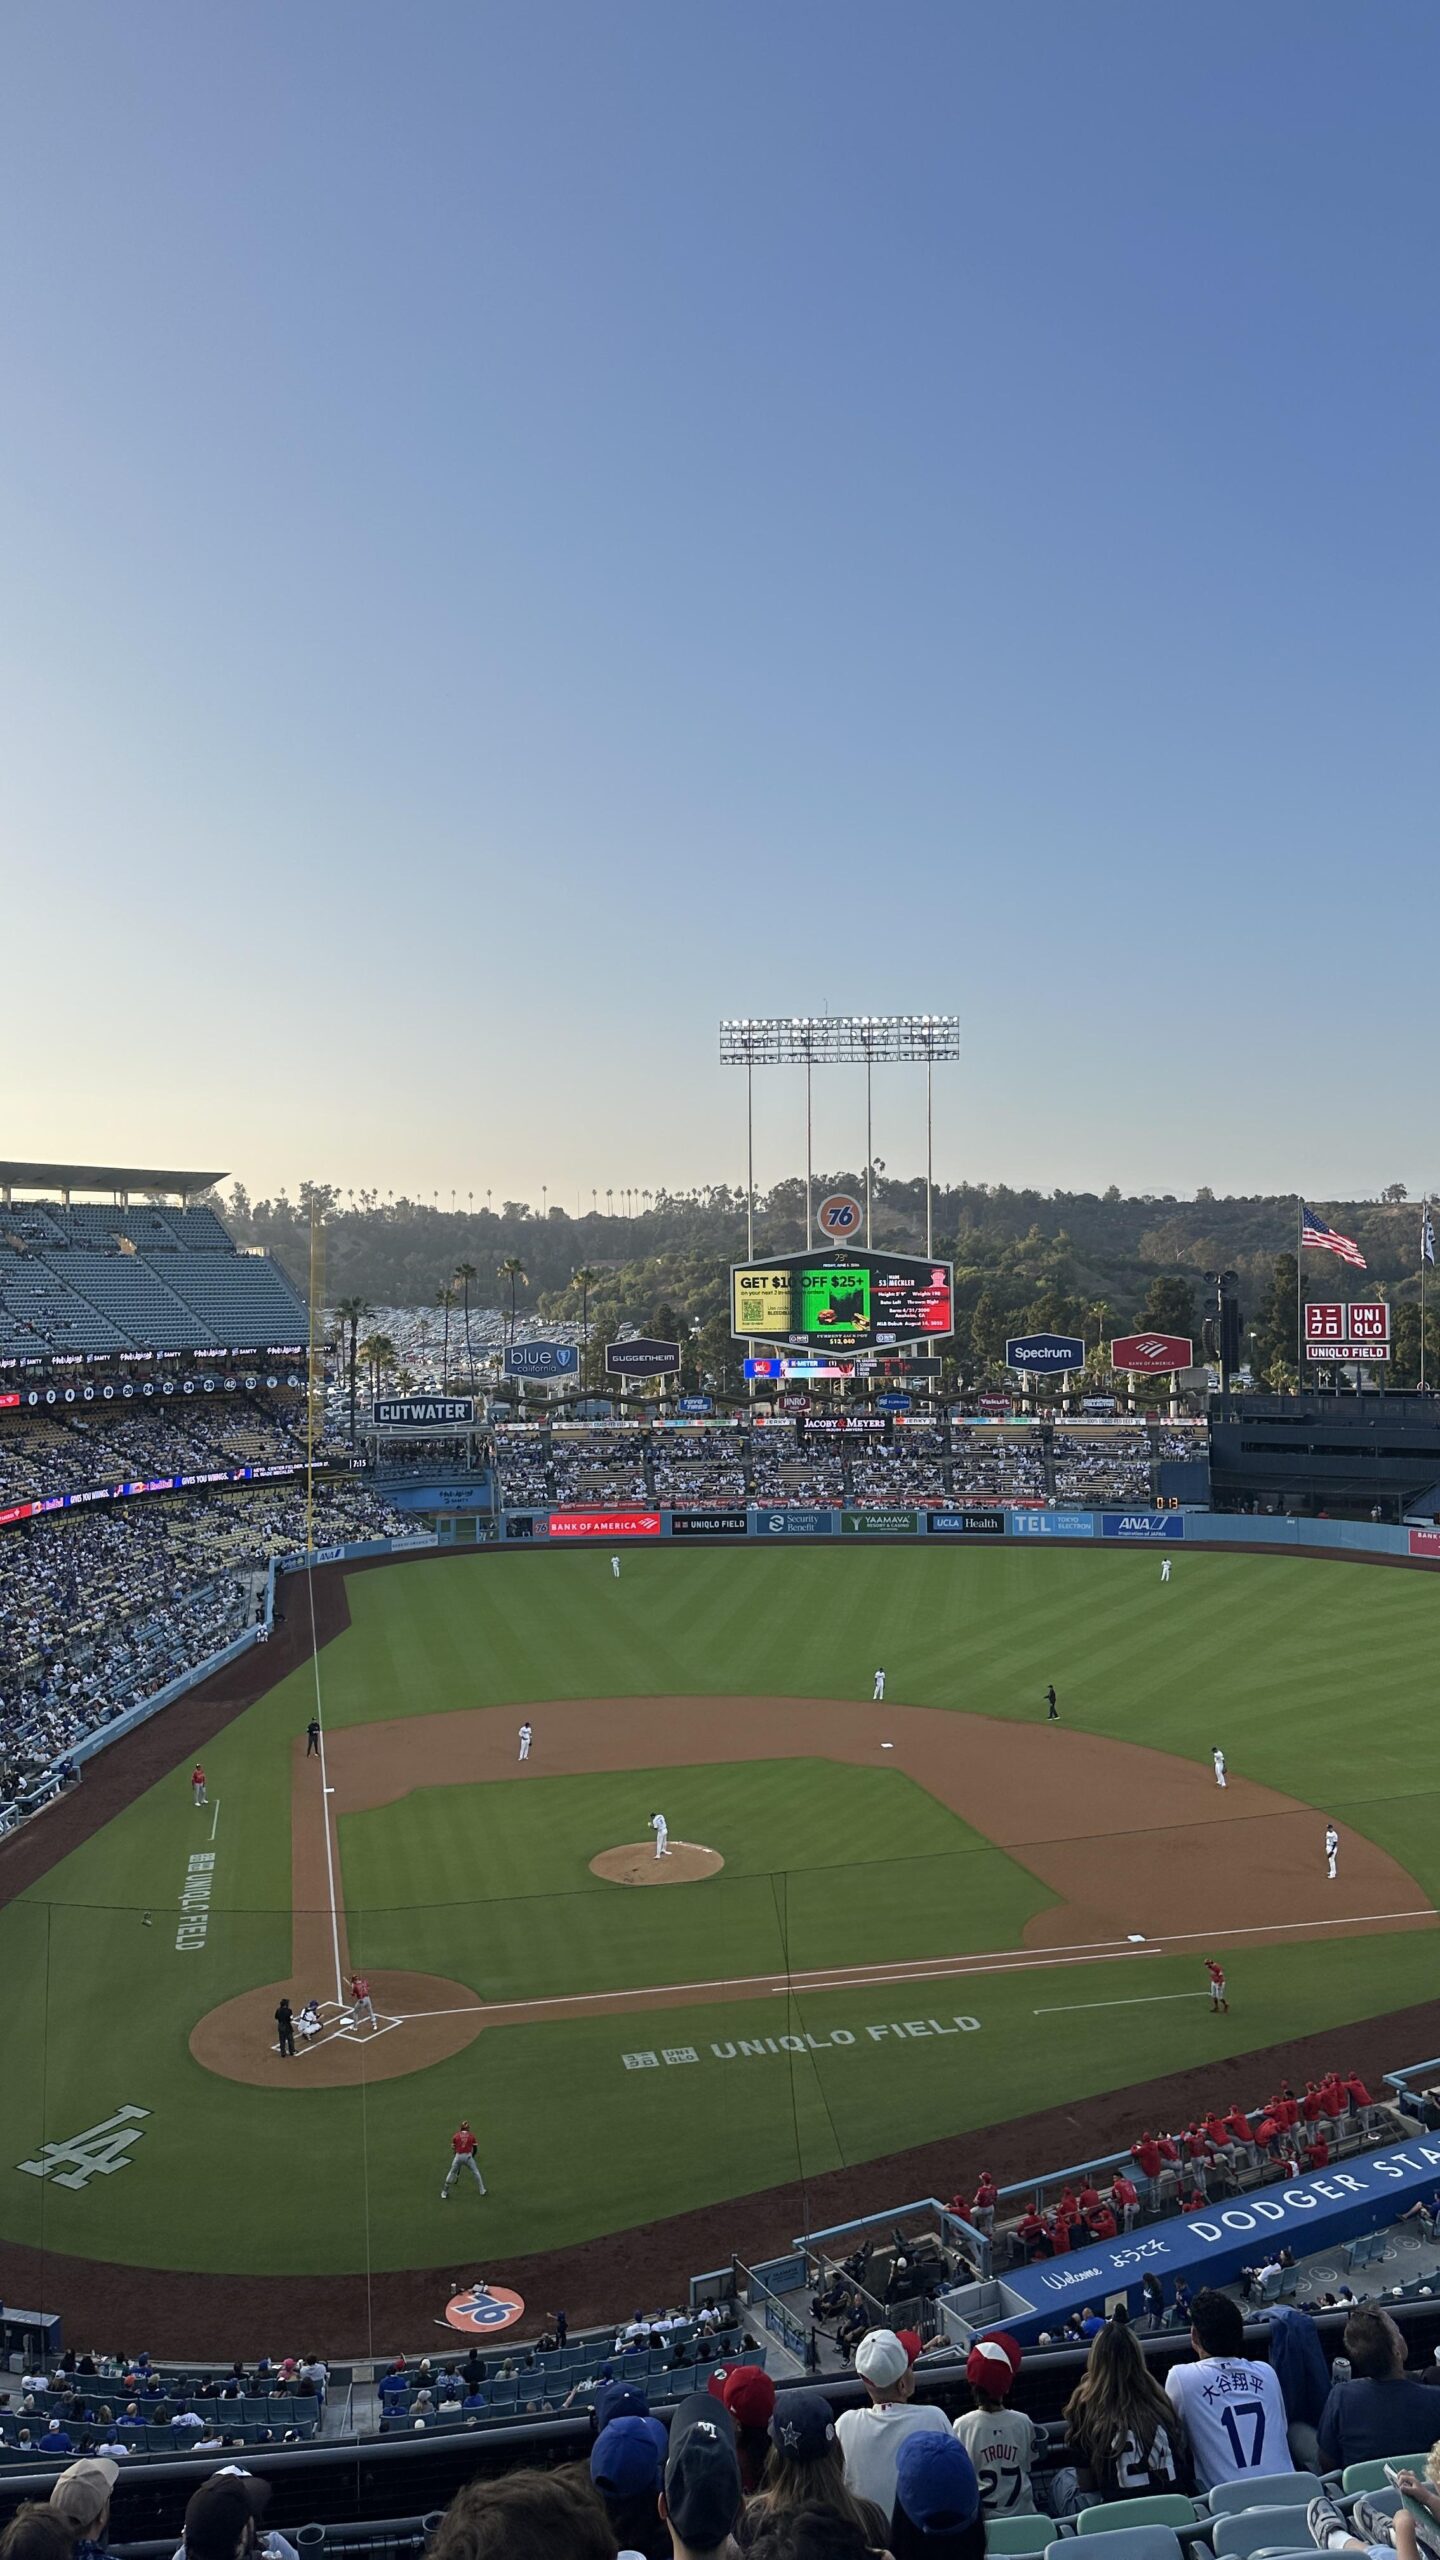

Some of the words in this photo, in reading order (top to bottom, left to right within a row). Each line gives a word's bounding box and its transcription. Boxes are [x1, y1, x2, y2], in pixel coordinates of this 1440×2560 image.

[827, 1205, 854, 1226] 76
[741, 1276, 769, 1288] GET
[801, 1276, 828, 1289] OFF
[831, 1275, 864, 1288] $25+
[1353, 1308, 1380, 1321] UNI
[1353, 1322, 1383, 1337] QLO
[511, 1349, 552, 1365] blue
[612, 1354, 675, 1362] GUGGENHEIM
[1014, 1347, 1072, 1361] Spectrum
[1311, 1347, 1349, 1359] UNIQLO
[1352, 1347, 1384, 1358] FIELD
[517, 1364, 557, 1373] california
[784, 1398, 806, 1408] JINRO
[380, 1403, 466, 1420] CUTWATER
[804, 1417, 837, 1428] JACOBY
[838, 1418, 847, 1427] &
[846, 1417, 886, 1428] MEYERS
[353, 1459, 367, 1468] 7:15
[181, 1476, 196, 1486] GIVES
[196, 1475, 207, 1484] YOU
[70, 1493, 82, 1504] GIVES
[82, 1492, 91, 1502] YOU
[1168, 1497, 1178, 1510] 13
[551, 1523, 577, 1531] BANK
[581, 1523, 592, 1531] OF
[593, 1522, 637, 1530] AMERICA
[691, 1520, 720, 1529] UNIQLO
[721, 1520, 745, 1528] FIELD
[787, 1515, 819, 1525] Security
[938, 1519, 960, 1527] UCLA
[965, 1518, 998, 1528] Health
[1015, 1516, 1051, 1532] TEL
[1119, 1518, 1150, 1530] ANA
[536, 1522, 548, 1533] 76
[787, 1524, 815, 1532] Benefit
[320, 1552, 334, 1561] ANA
[178, 1872, 213, 1913] UNIQLO
[175, 1914, 209, 1951] FIELD
[711, 2030, 856, 2059] UNIQLO
[865, 2016, 982, 2042] FIELD
[666, 2049, 690, 2057] UNI
[669, 2054, 695, 2063] QLO
[16, 2103, 154, 2191] LA
[1041, 2267, 1103, 2290] Welcome
[1109, 2239, 1171, 2268] ようこそ
[1187, 2174, 1370, 2242] DODGER
[1372, 2141, 1440, 2178] STA
[450, 2292, 522, 2326] 76
[1202, 2372, 1264, 2406] 大谷翔平
[1221, 2401, 1266, 2469] 17
[981, 2444, 1018, 2463] TROUT
[1111, 2424, 1177, 2489] 24
[978, 2464, 1022, 2509] 27
